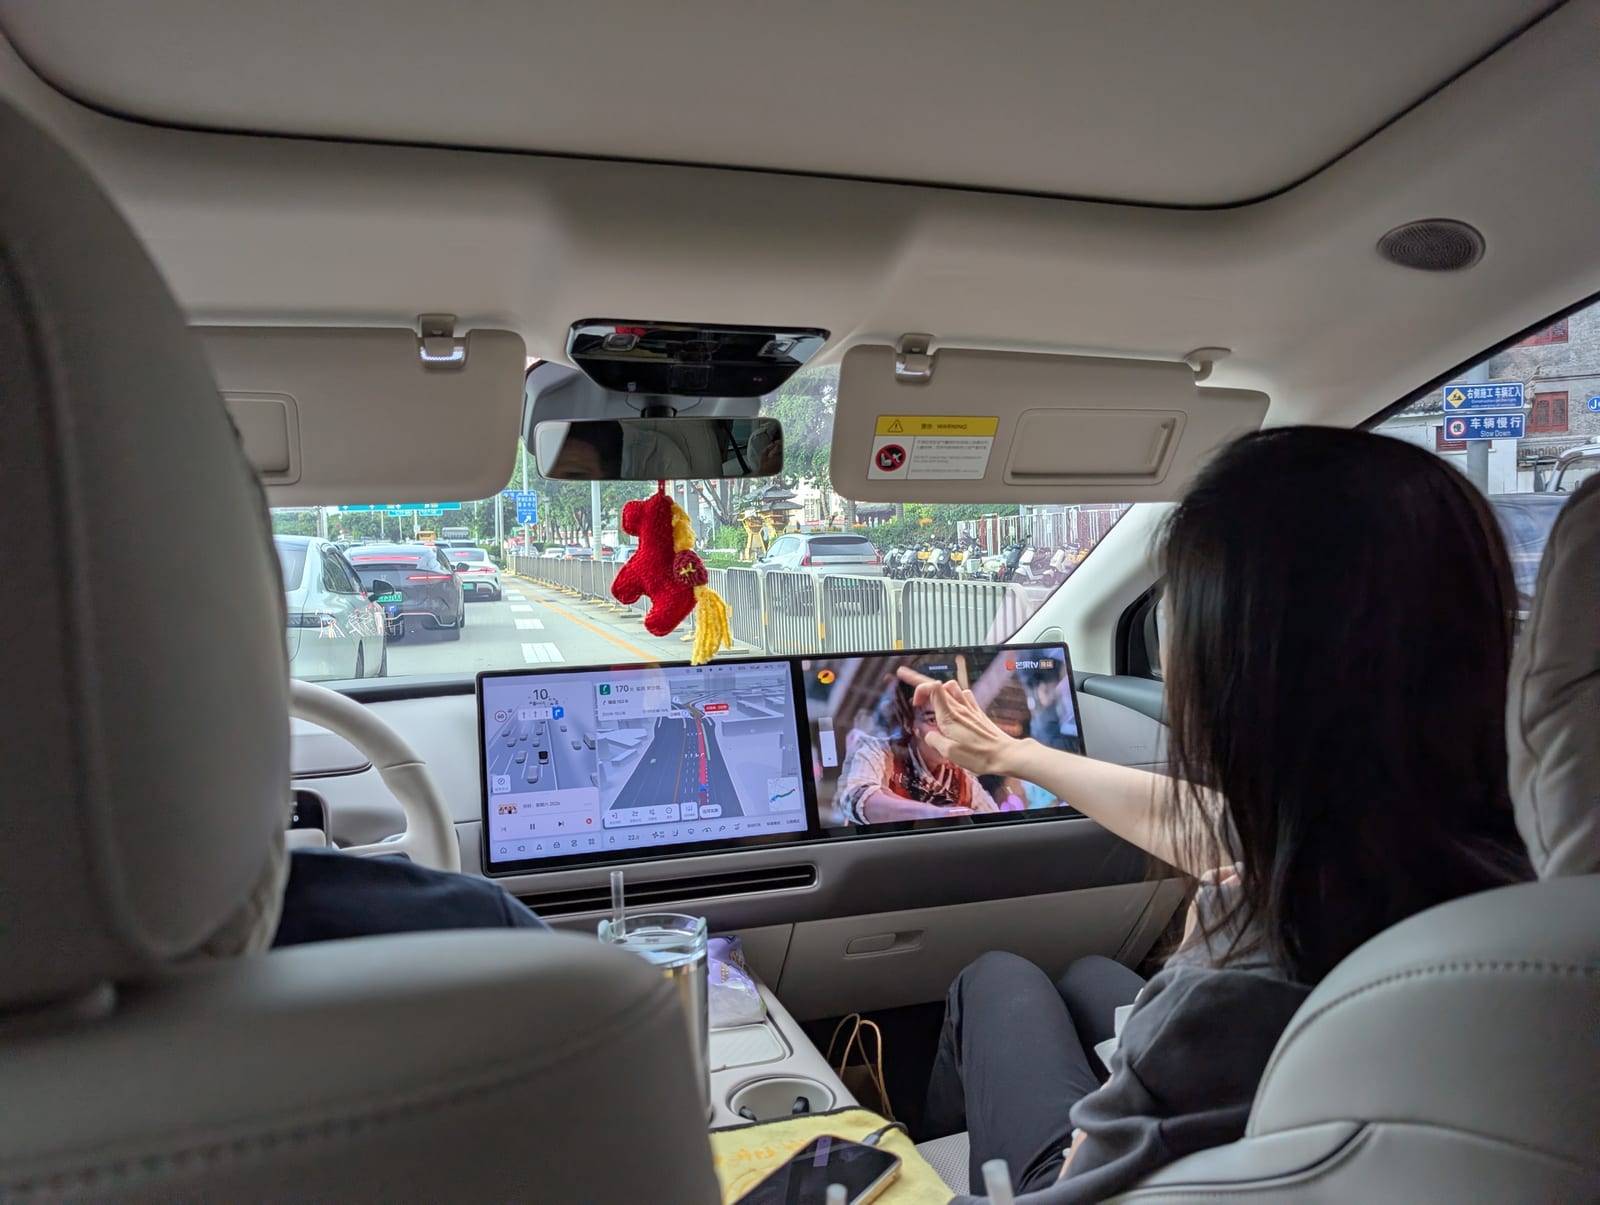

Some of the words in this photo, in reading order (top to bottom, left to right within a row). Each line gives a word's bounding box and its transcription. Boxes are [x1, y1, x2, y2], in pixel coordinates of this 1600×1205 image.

[1470, 417, 1521, 429] 车辆慢行
[532, 688, 549, 701] 10
[615, 684, 630, 693] 170
